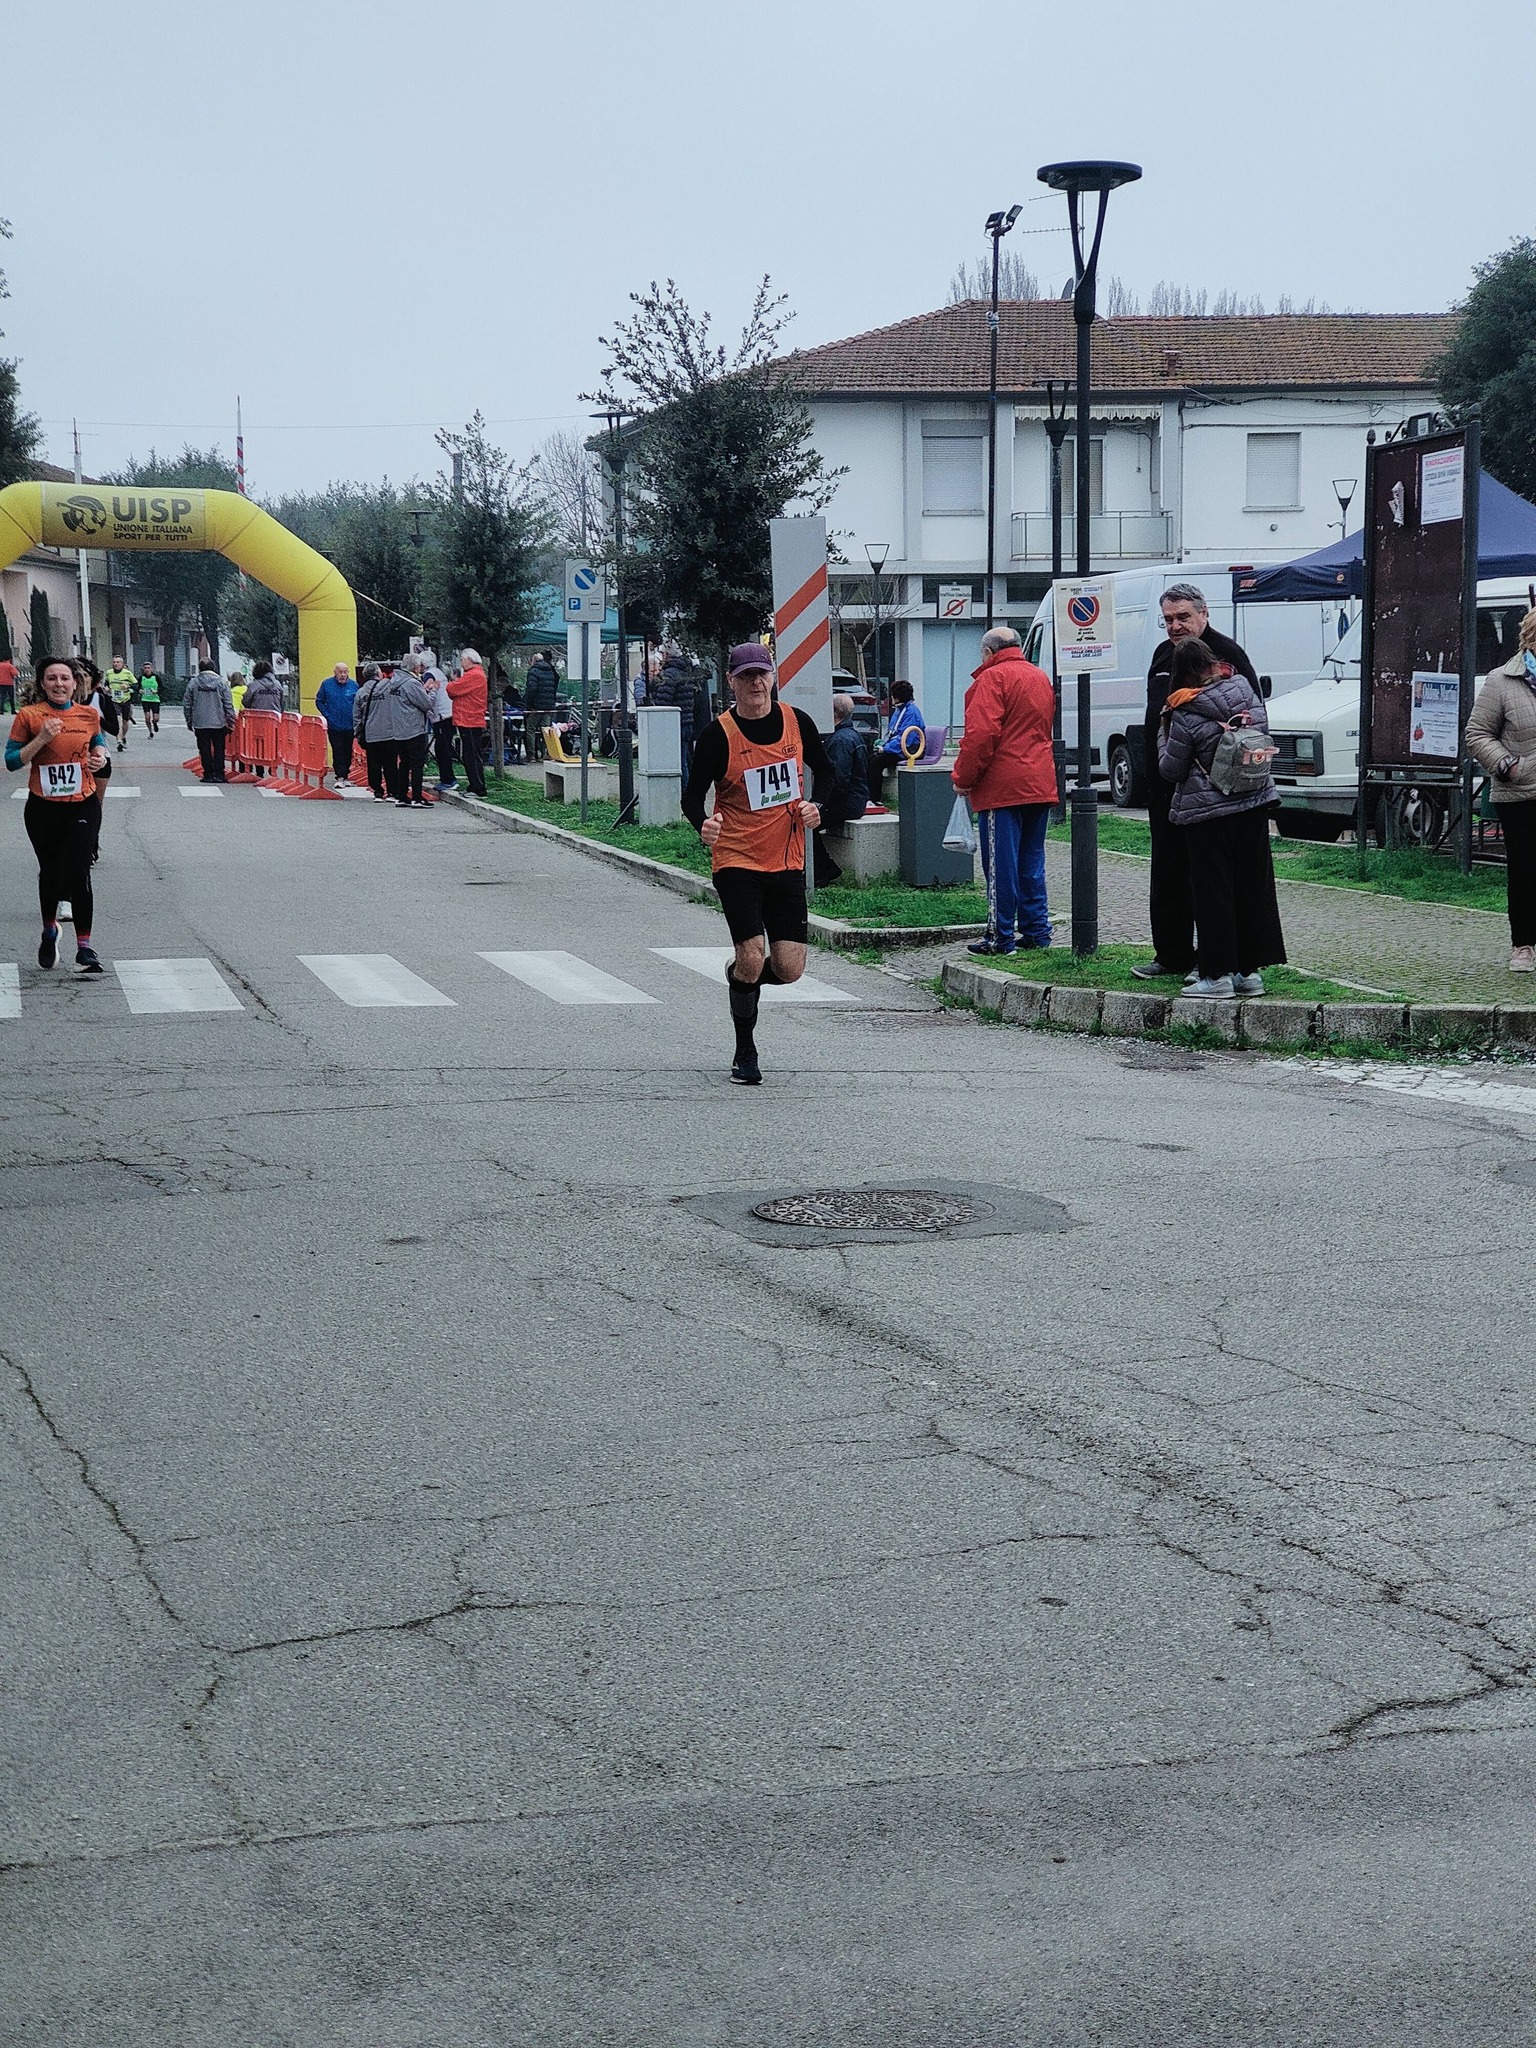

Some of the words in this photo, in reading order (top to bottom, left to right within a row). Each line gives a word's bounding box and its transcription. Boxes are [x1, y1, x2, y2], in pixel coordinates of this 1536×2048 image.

[112, 496, 191, 523] UISP
[113, 523, 148, 533] UNIONE
[152, 525, 193, 534] ITALIANA
[113, 532, 141, 541] SPORT
[145, 533, 160, 541] PER
[164, 534, 188, 542] TUTTI
[570, 599, 579, 609] P
[48, 764, 76, 785] 642
[756, 762, 791, 794] 744
